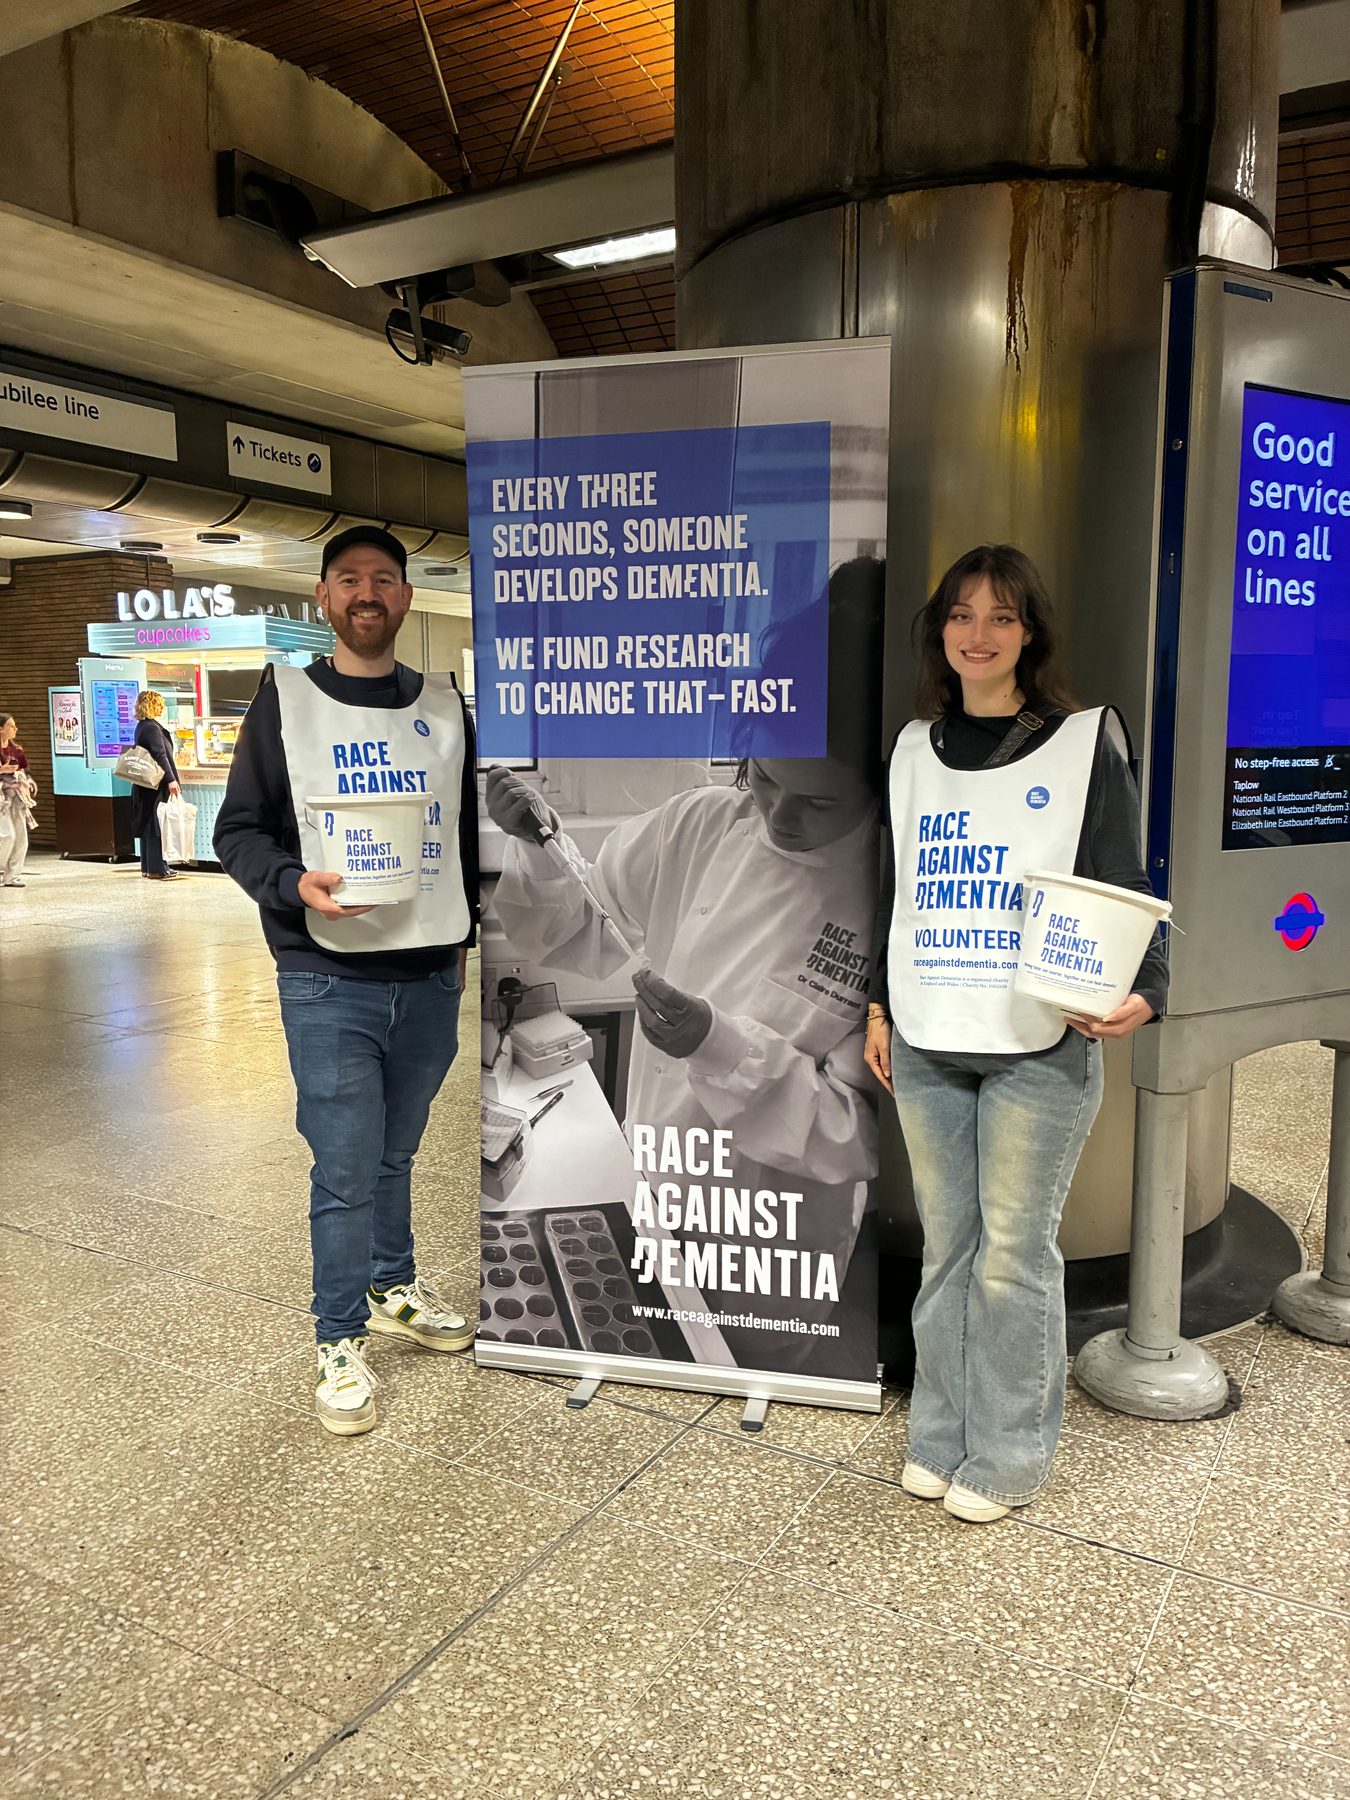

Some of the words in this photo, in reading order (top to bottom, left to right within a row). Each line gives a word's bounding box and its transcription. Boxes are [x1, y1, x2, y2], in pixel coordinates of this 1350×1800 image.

[64, 395, 100, 420] line
[249, 440, 302, 467] Tickets
[1252, 421, 1335, 467] Good
[493, 476, 569, 512] EVERY
[578, 471, 657, 509] THREE
[1249, 478, 1350, 517] service
[493, 520, 616, 559] SECONDS,
[623, 514, 748, 553] SOMEONE
[1247, 528, 1285, 558] on
[1295, 525, 1332, 561] all
[494, 566, 618, 603] DEVELOPS
[627, 561, 769, 600] DEMENTIA.
[1245, 567, 1316, 607] lines
[117, 583, 235, 621] LOLA'S
[137, 623, 211, 646] cupcakes
[495, 637, 534, 670] WE
[543, 636, 608, 670] FUND
[616, 632, 750, 669] RESEARCH
[496, 681, 525, 715] TO
[534, 681, 635, 715] CHANGE
[731, 678, 797, 714] FAST.
[333, 741, 391, 768] RACE
[1235, 758, 1248, 768] No
[1250, 757, 1290, 770] step-free
[1292, 758, 1320, 767] access
[338, 770, 427, 794] AGAINST
[1233, 780, 1260, 792] Taplow
[1233, 794, 1262, 804] National
[1264, 793, 1276, 802] Rail
[1278, 792, 1313, 802] Eastbound
[1314, 790, 1342, 800] Platform
[1343, 790, 1348, 799] 2
[1232, 808, 1262, 817] National
[1262, 806, 1276, 815] Rail
[1276, 804, 1315, 814] Westbound
[1316, 803, 1344, 812] Platform
[1345, 803, 1350, 811] 3
[1232, 821, 1263, 830] Elizabeth
[1264, 820, 1277, 828] line
[1278, 818, 1313, 828] Eastbound
[1314, 816, 1342, 825] Platform
[1343, 815, 1348, 824] 2
[346, 828, 373, 842] RACE
[918, 811, 970, 843] RACE
[346, 842, 392, 857] AGAINST
[347, 856, 402, 872] DEMENTIA
[917, 844, 1009, 877] AGAINST
[915, 879, 1023, 911] DEMENTIA
[821, 921, 857, 949] RACE
[1048, 913, 1080, 934] RACE
[914, 928, 1021, 951] VOLUNTEER
[1044, 930, 1098, 956] AGAINST
[812, 937, 870, 973] AGAINST
[1040, 947, 1104, 976] DEMENTIA
[798, 974, 808, 983] Dr
[808, 980, 830, 995] Claire
[806, 953, 871, 994] DEMENTIA
[633, 1124, 733, 1178] RACE
[631, 1180, 804, 1241] AGAINST
[630, 1236, 840, 1302] DEMENTIA
[632, 1305, 840, 1337] www.raceagainstdementia.com
